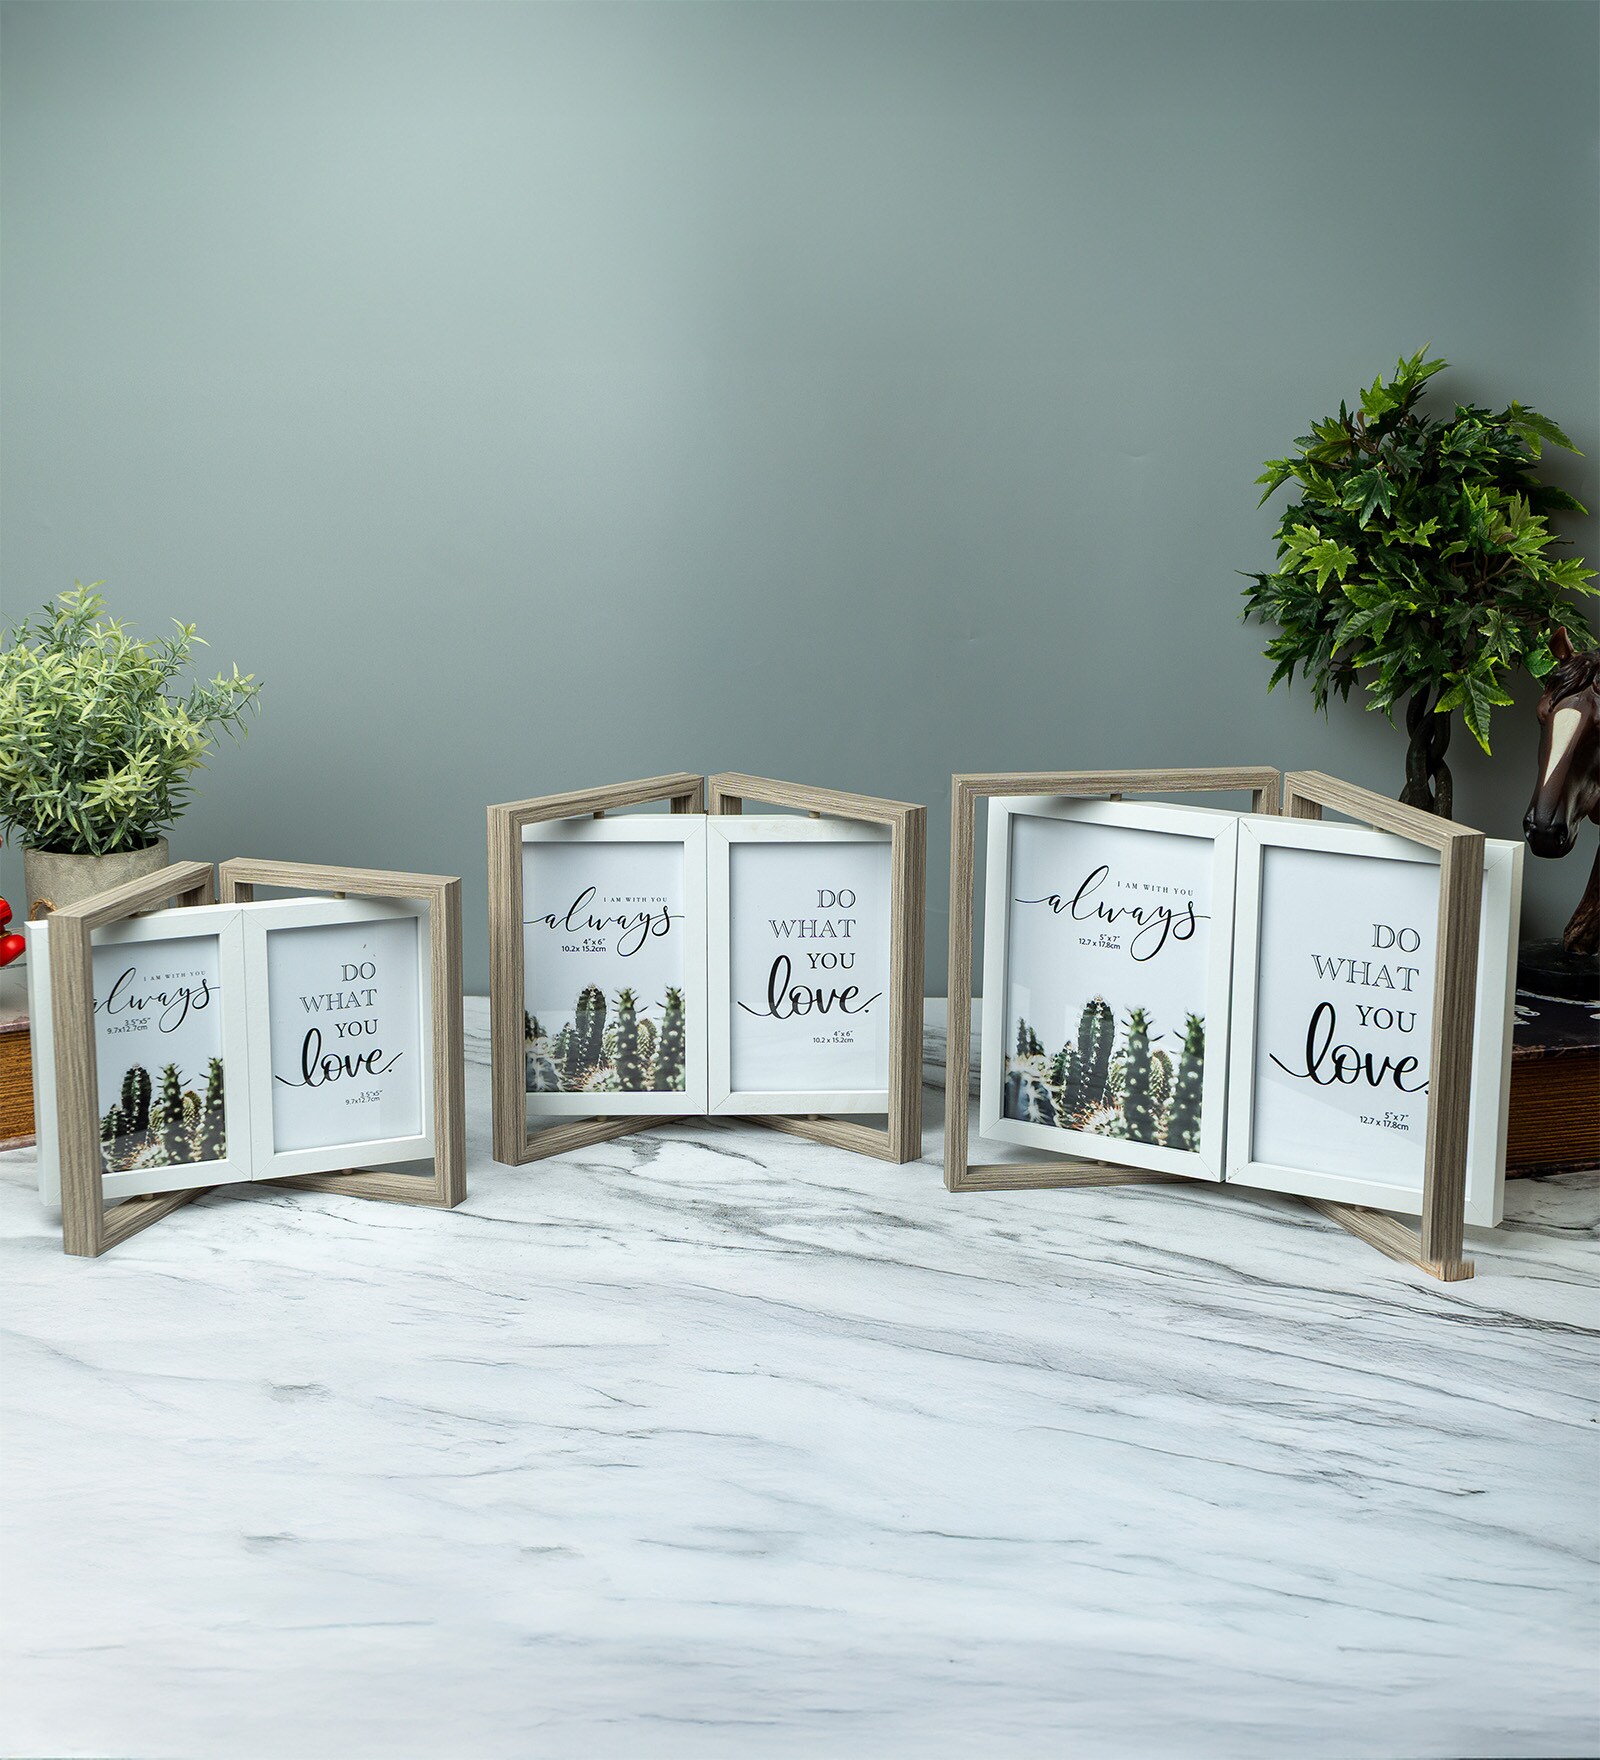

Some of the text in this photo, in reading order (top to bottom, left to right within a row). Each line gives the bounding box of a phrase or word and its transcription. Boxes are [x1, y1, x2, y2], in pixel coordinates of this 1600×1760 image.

[817, 889, 856, 909] DO
[1125, 882, 1138, 890] AM
[1143, 884, 1169, 894] WITH
[1173, 888, 1194, 897] YOU
[523, 886, 685, 957] always
[1015, 865, 1211, 962] always
[769, 919, 857, 939] WHAT
[1371, 923, 1421, 953] DO
[1078, 937, 1092, 946] 12.7
[806, 952, 856, 970] YOU
[341, 961, 377, 983] DO
[1311, 954, 1420, 992] WHAT
[299, 988, 378, 1014] WHAT
[335, 1018, 379, 1039] YOU
[1355, 1004, 1418, 1033] YOU
[1359, 1115, 1375, 1125] 12.7
